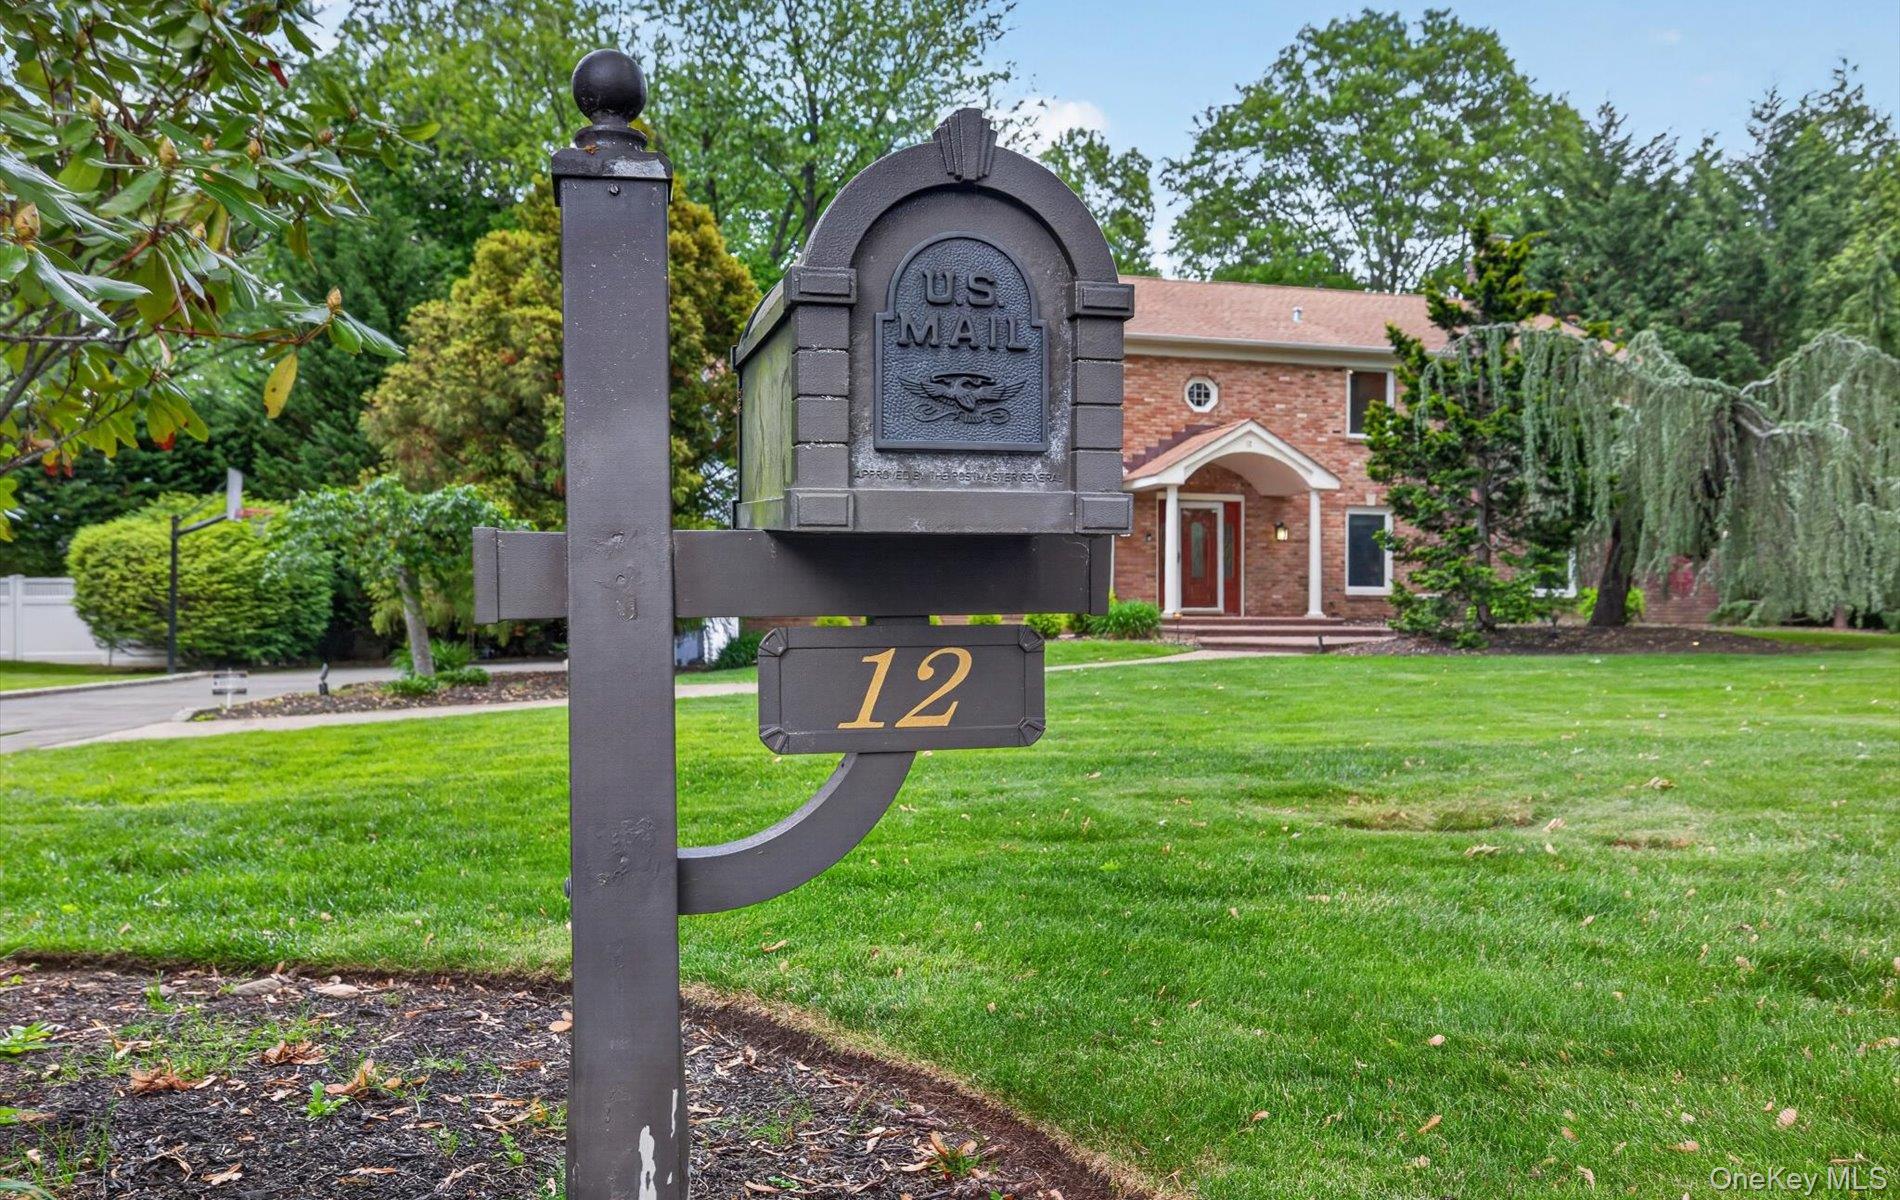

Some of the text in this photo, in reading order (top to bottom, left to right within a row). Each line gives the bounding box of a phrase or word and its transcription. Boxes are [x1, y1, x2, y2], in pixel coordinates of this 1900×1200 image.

[922, 270, 1005, 308] U.S.
[896, 313, 1028, 352] MAIL
[952, 471, 1018, 483] POSTMASTER
[1020, 472, 1063, 483] GENERAL
[836, 646, 973, 730] 12
